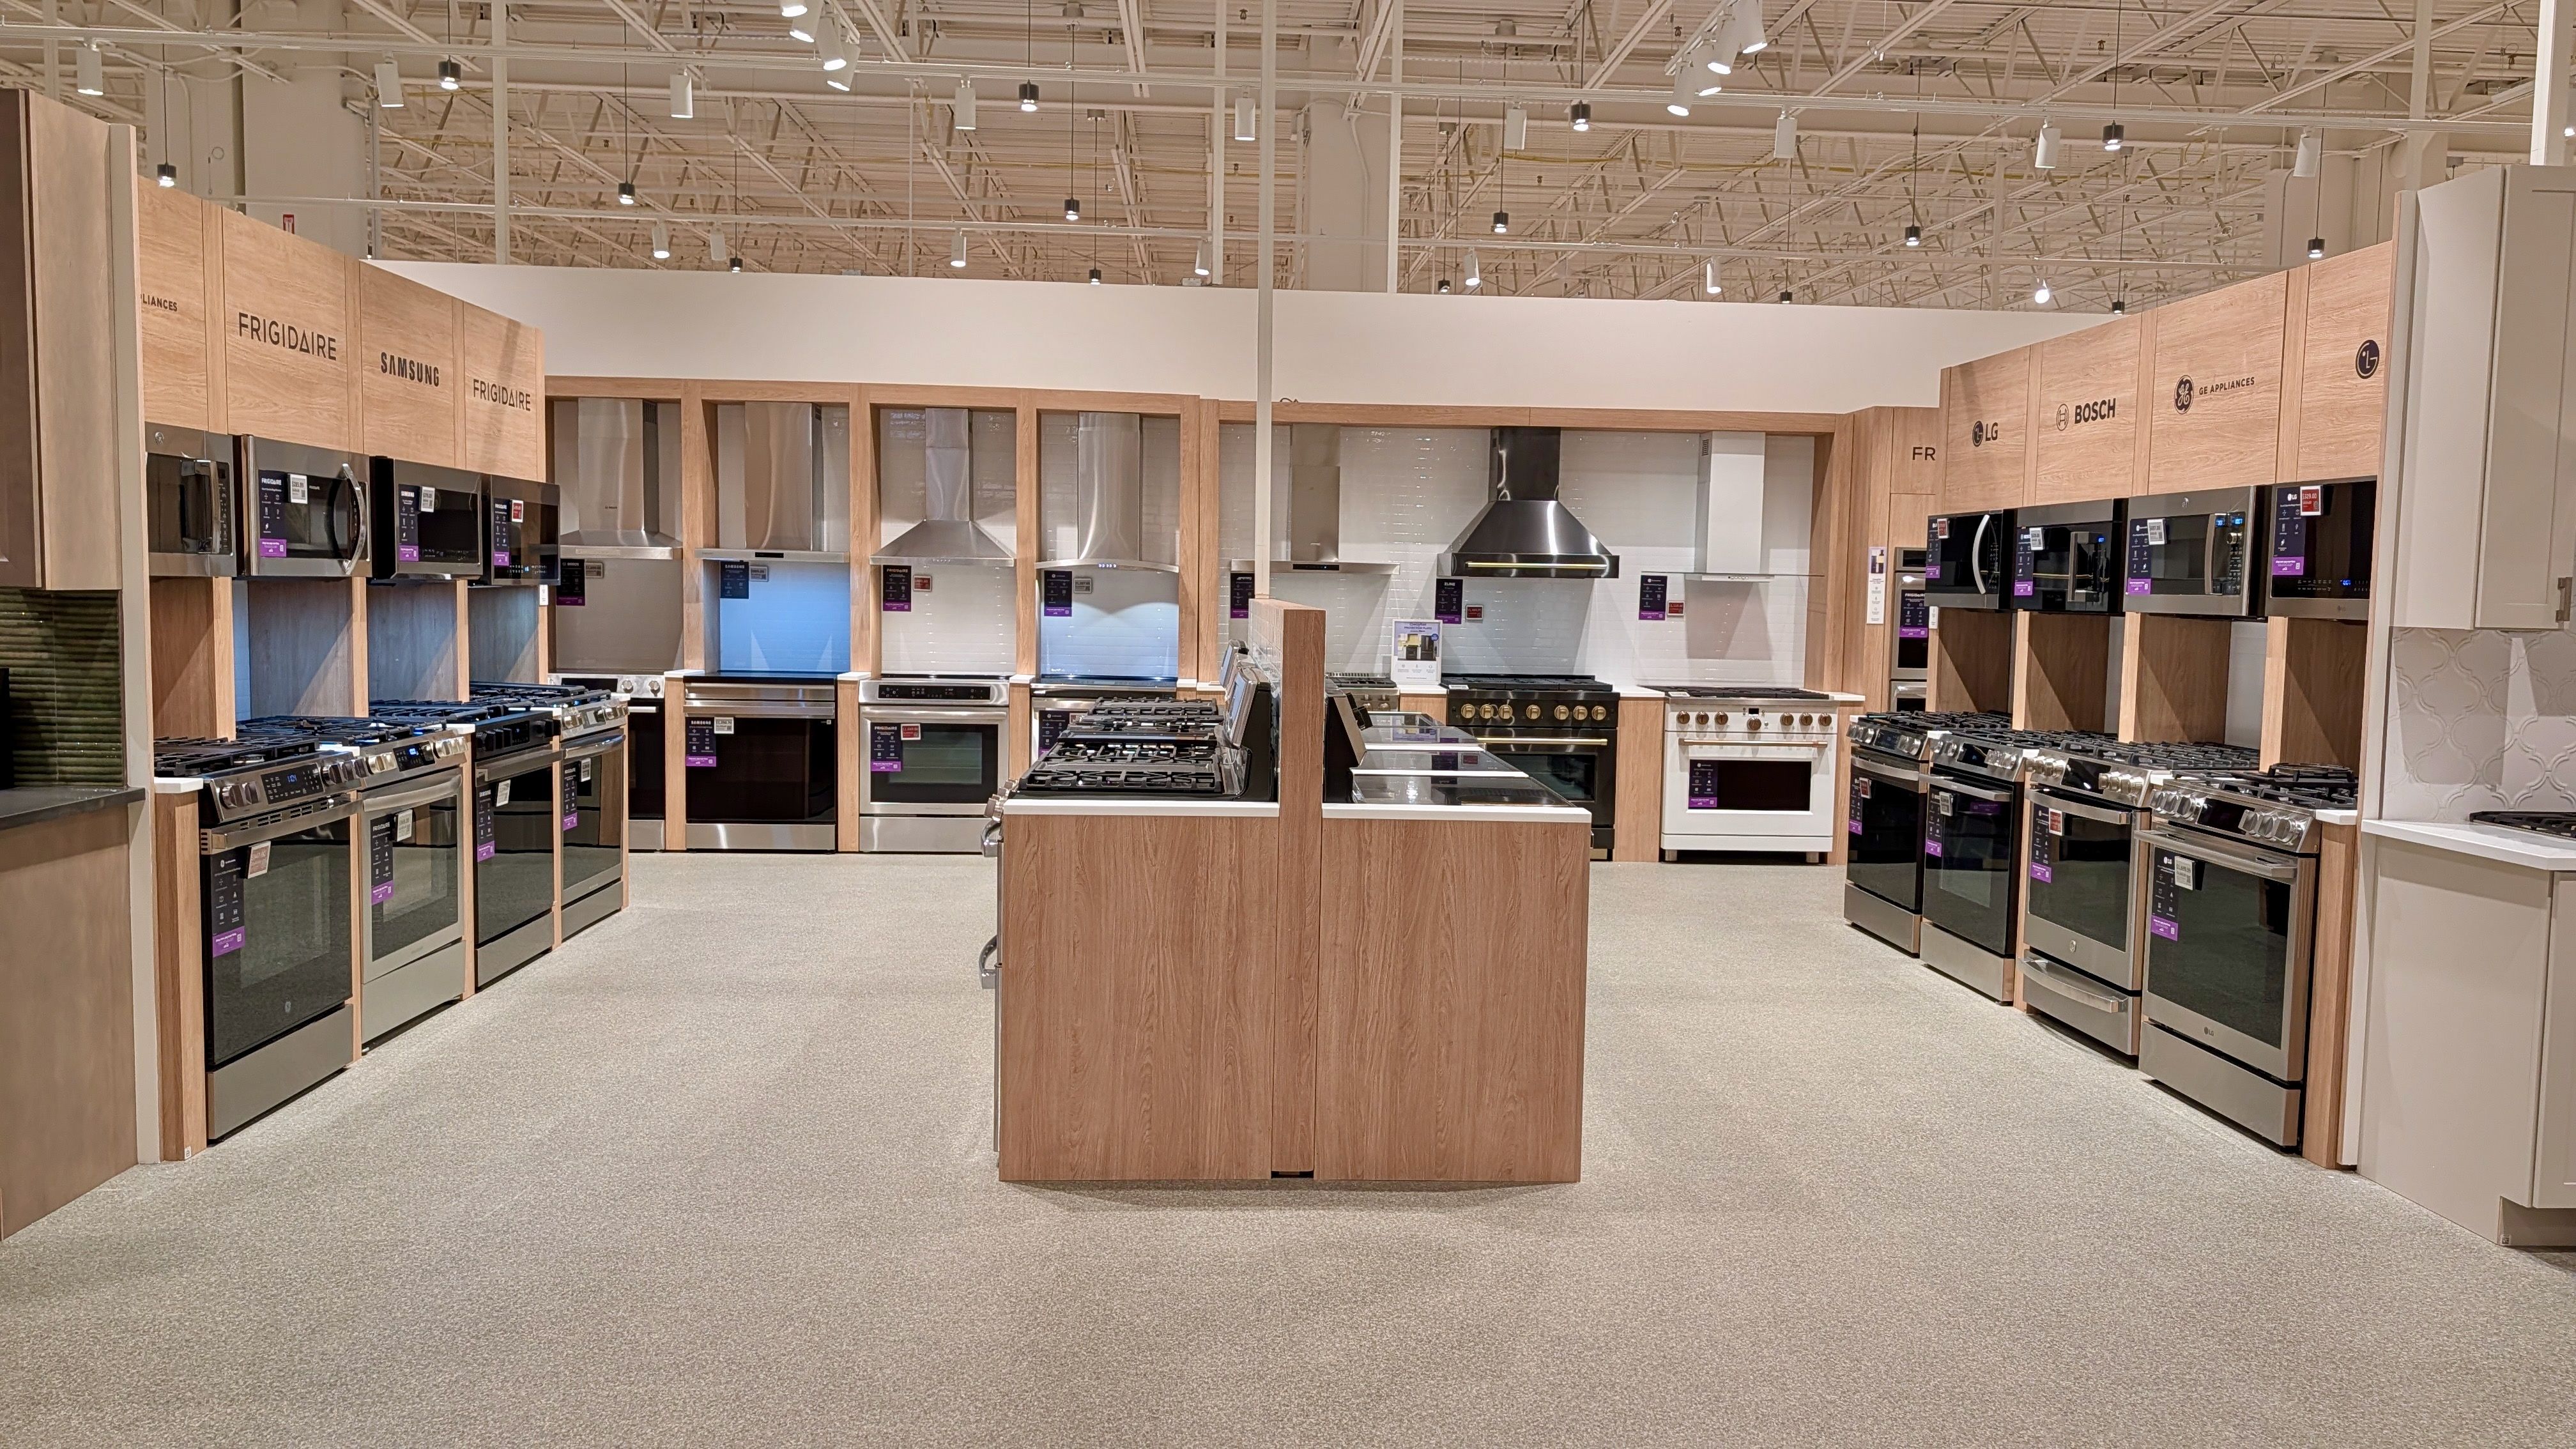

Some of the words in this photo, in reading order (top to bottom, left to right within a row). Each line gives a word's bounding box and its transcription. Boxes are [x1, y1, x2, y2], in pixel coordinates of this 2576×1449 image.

[239, 312, 337, 361] FRIGIDAIRE
[381, 351, 440, 387] SAMSUNG
[473, 378, 531, 411] FRIGIDAIRE
[2198, 386, 2208, 395] GE
[2210, 376, 2255, 394] APPLIANCES
[2074, 397, 2117, 424] BOSCH
[1985, 422, 1998, 441] LG
